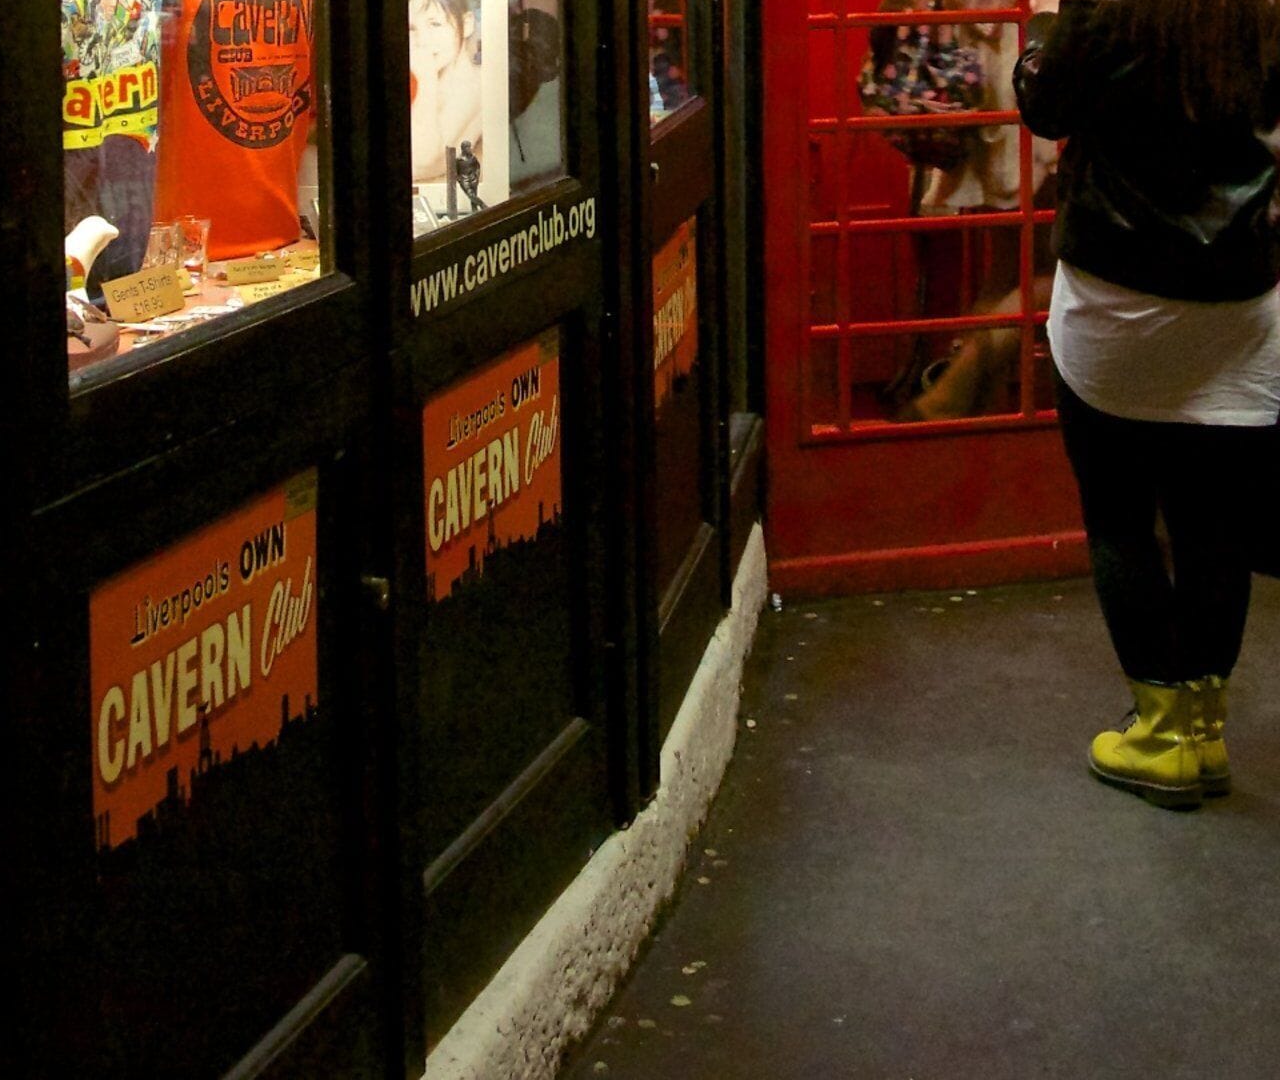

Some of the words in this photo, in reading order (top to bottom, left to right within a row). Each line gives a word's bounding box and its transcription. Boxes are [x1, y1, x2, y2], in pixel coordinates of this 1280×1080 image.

[112, 285, 140, 304] Gents
[140, 275, 172, 296] T-Shirts
[410, 197, 596, 318] www.cavernclub.org
[446, 390, 506, 452] Liverpools
[511, 366, 541, 409] OWN
[428, 427, 520, 552] CAVERN
[524, 394, 558, 486] Club
[131, 558, 230, 648] Liverpools
[239, 521, 287, 583] OWN
[97, 603, 252, 784] CAVERN
[260, 555, 313, 677] Club
